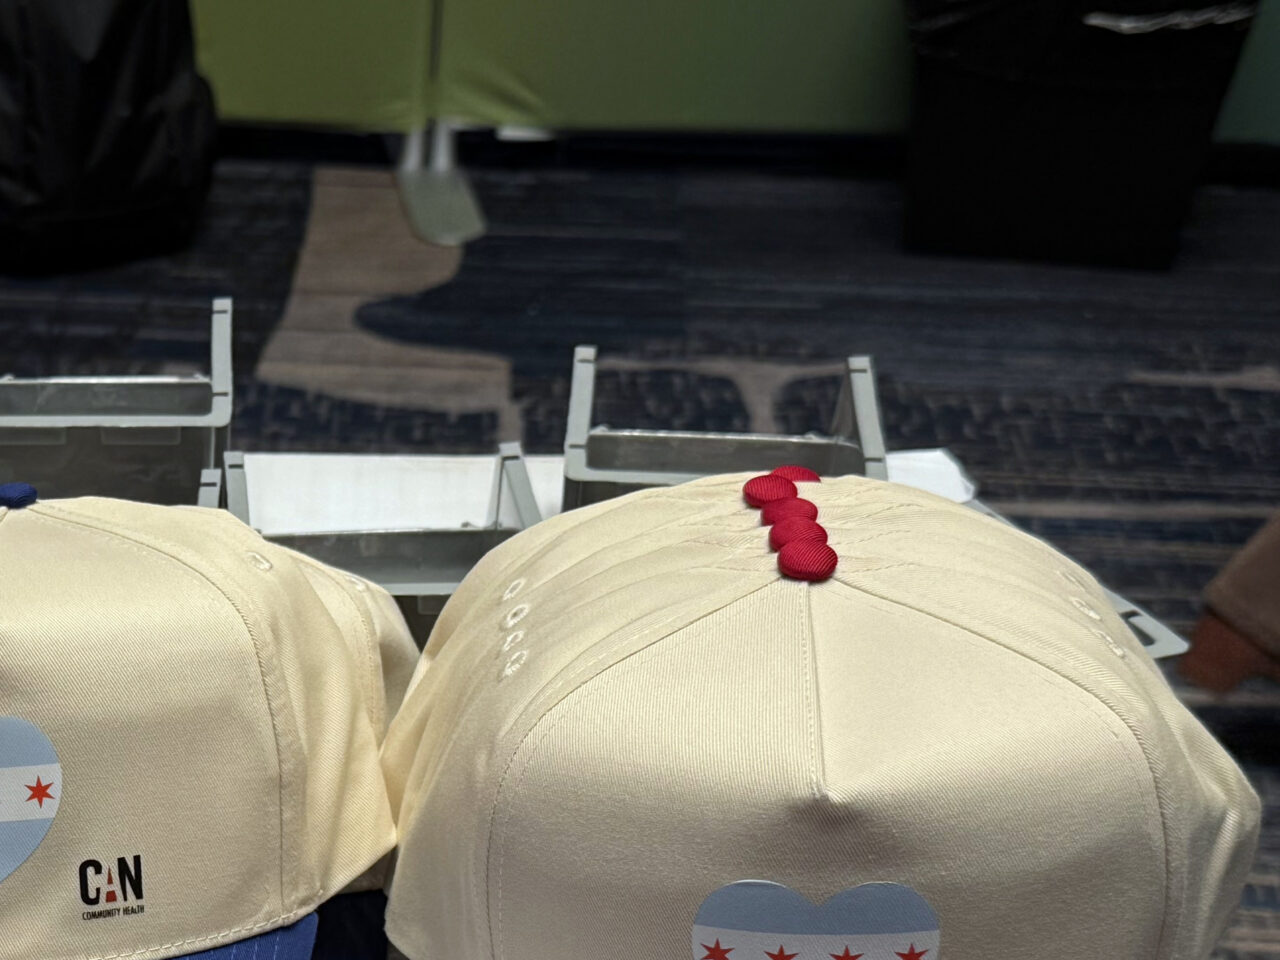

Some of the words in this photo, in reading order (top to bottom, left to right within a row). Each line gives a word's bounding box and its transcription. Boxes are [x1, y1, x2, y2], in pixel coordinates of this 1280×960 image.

[79, 855, 143, 905] CAN
[82, 908, 121, 920] COMMUNITY
[122, 905, 145, 916] HEALTH
